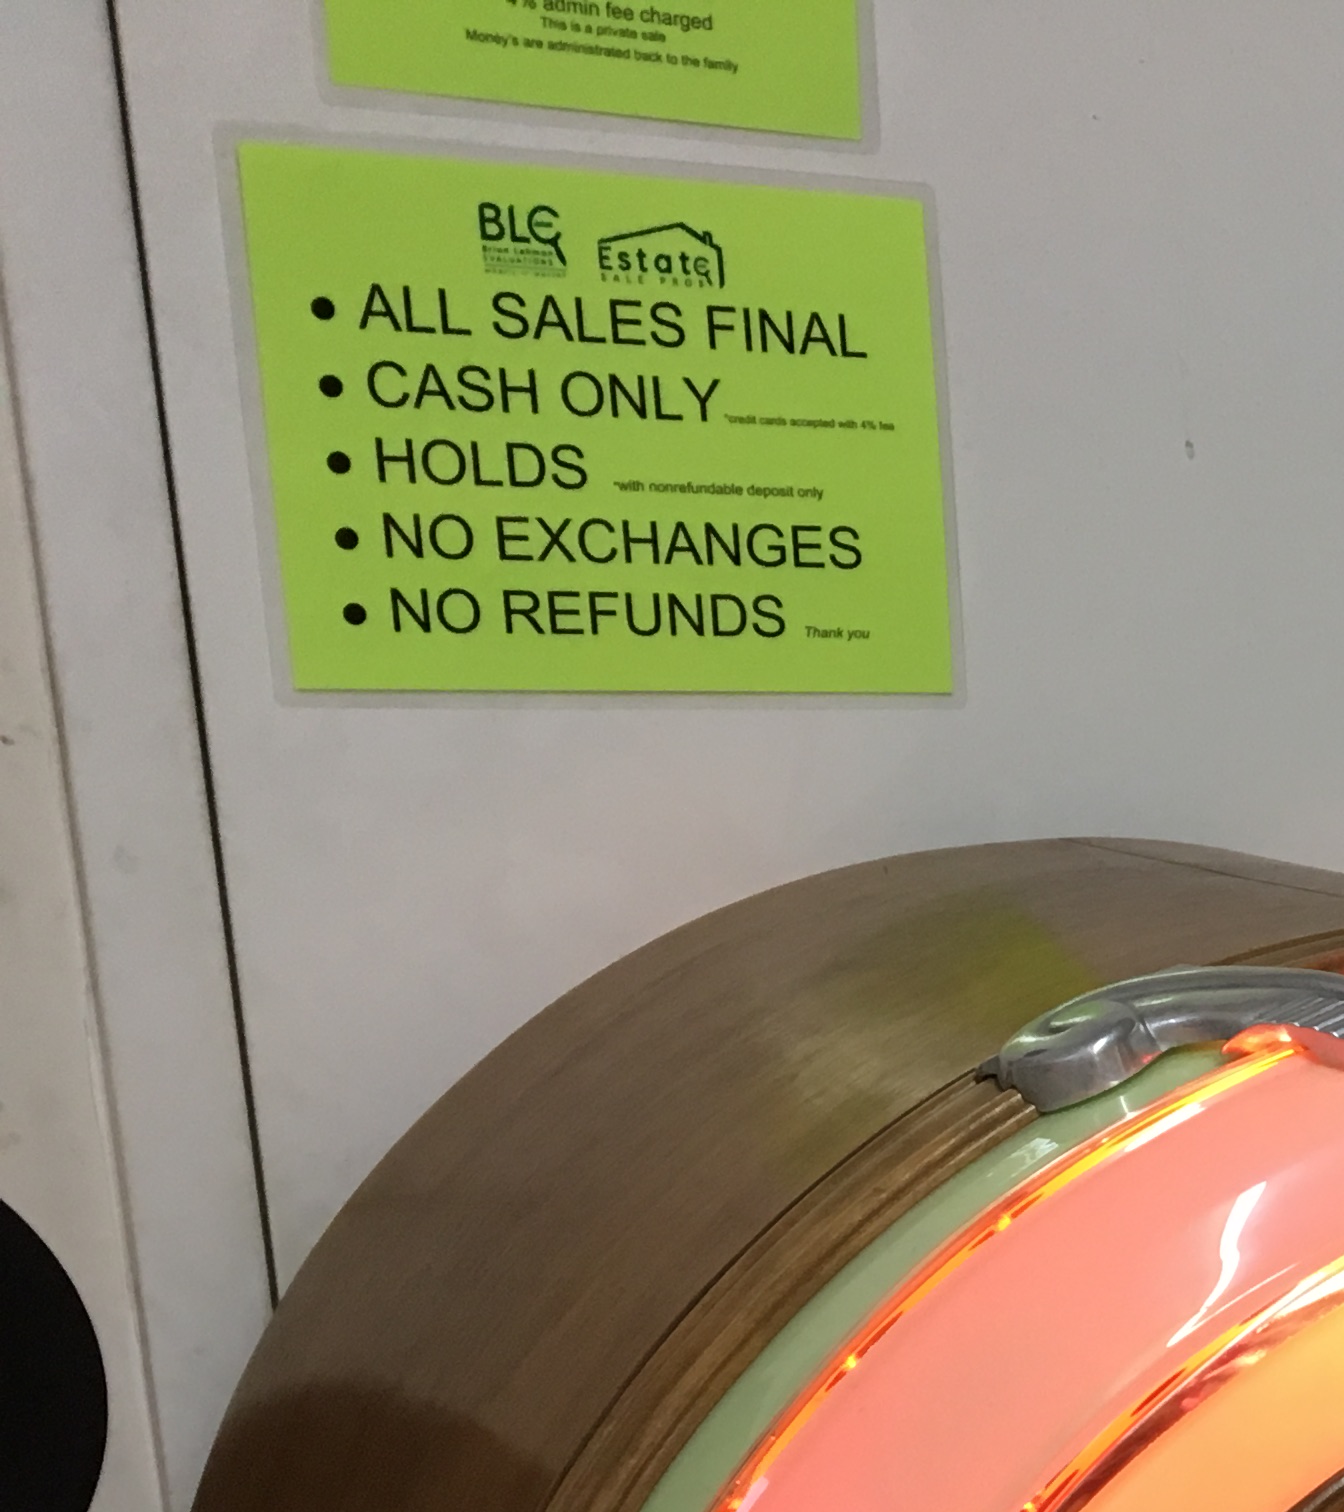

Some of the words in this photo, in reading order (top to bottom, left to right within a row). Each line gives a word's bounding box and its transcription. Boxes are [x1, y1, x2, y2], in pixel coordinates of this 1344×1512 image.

[540, 16, 568, 31] This
[570, 19, 581, 33] is
[584, 24, 593, 34] a
[596, 24, 638, 41] private
[641, 30, 666, 43] sale
[543, 0, 600, 18] admin
[605, 2, 634, 22] fee
[639, 6, 714, 33] charged
[465, 27, 519, 48] Money's
[523, 37, 544, 49] are
[634, 48, 662, 64] back
[666, 53, 678, 65] to
[681, 55, 700, 68] the
[703, 57, 738, 74] family
[598, 241, 713, 286] Estate
[601, 273, 645, 286] SALE
[359, 283, 472, 338] ALL
[491, 290, 686, 349] SALES
[706, 304, 869, 359] FINAL
[367, 360, 540, 414] CASH
[561, 369, 721, 422] ONLY
[759, 415, 787, 426] cards
[790, 418, 835, 430] accepted
[838, 419, 858, 429] with
[376, 437, 589, 491] HOLDS
[649, 482, 743, 496] nonrefundable
[747, 484, 794, 499] deposit
[797, 486, 824, 500] only
[382, 512, 474, 560] NO
[496, 515, 863, 571] EXCHANGES
[390, 587, 482, 635] NO
[504, 590, 787, 640] REFUNDS
[804, 626, 840, 640] Thank
[843, 629, 871, 643] you
